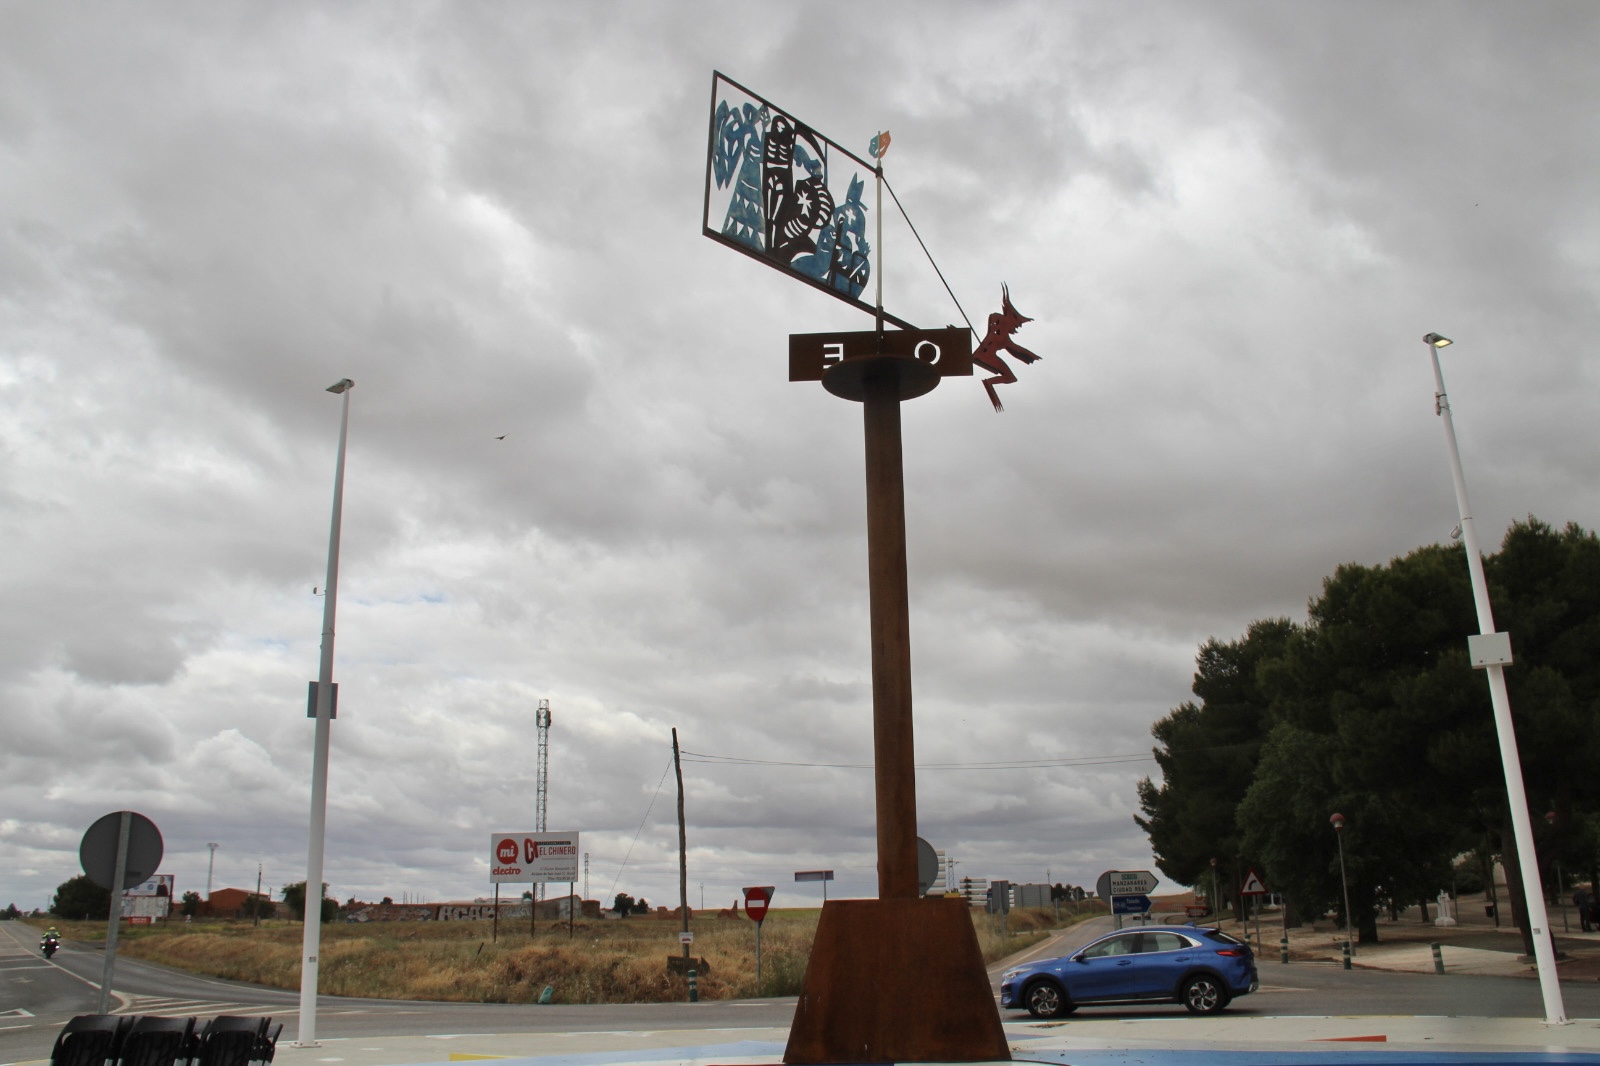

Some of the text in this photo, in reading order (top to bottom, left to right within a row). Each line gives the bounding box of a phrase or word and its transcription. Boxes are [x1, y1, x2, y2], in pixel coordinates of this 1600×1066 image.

[500, 845, 515, 858] mi
[540, 846, 576, 856] EL CHINERO
[493, 866, 521, 875] electro
